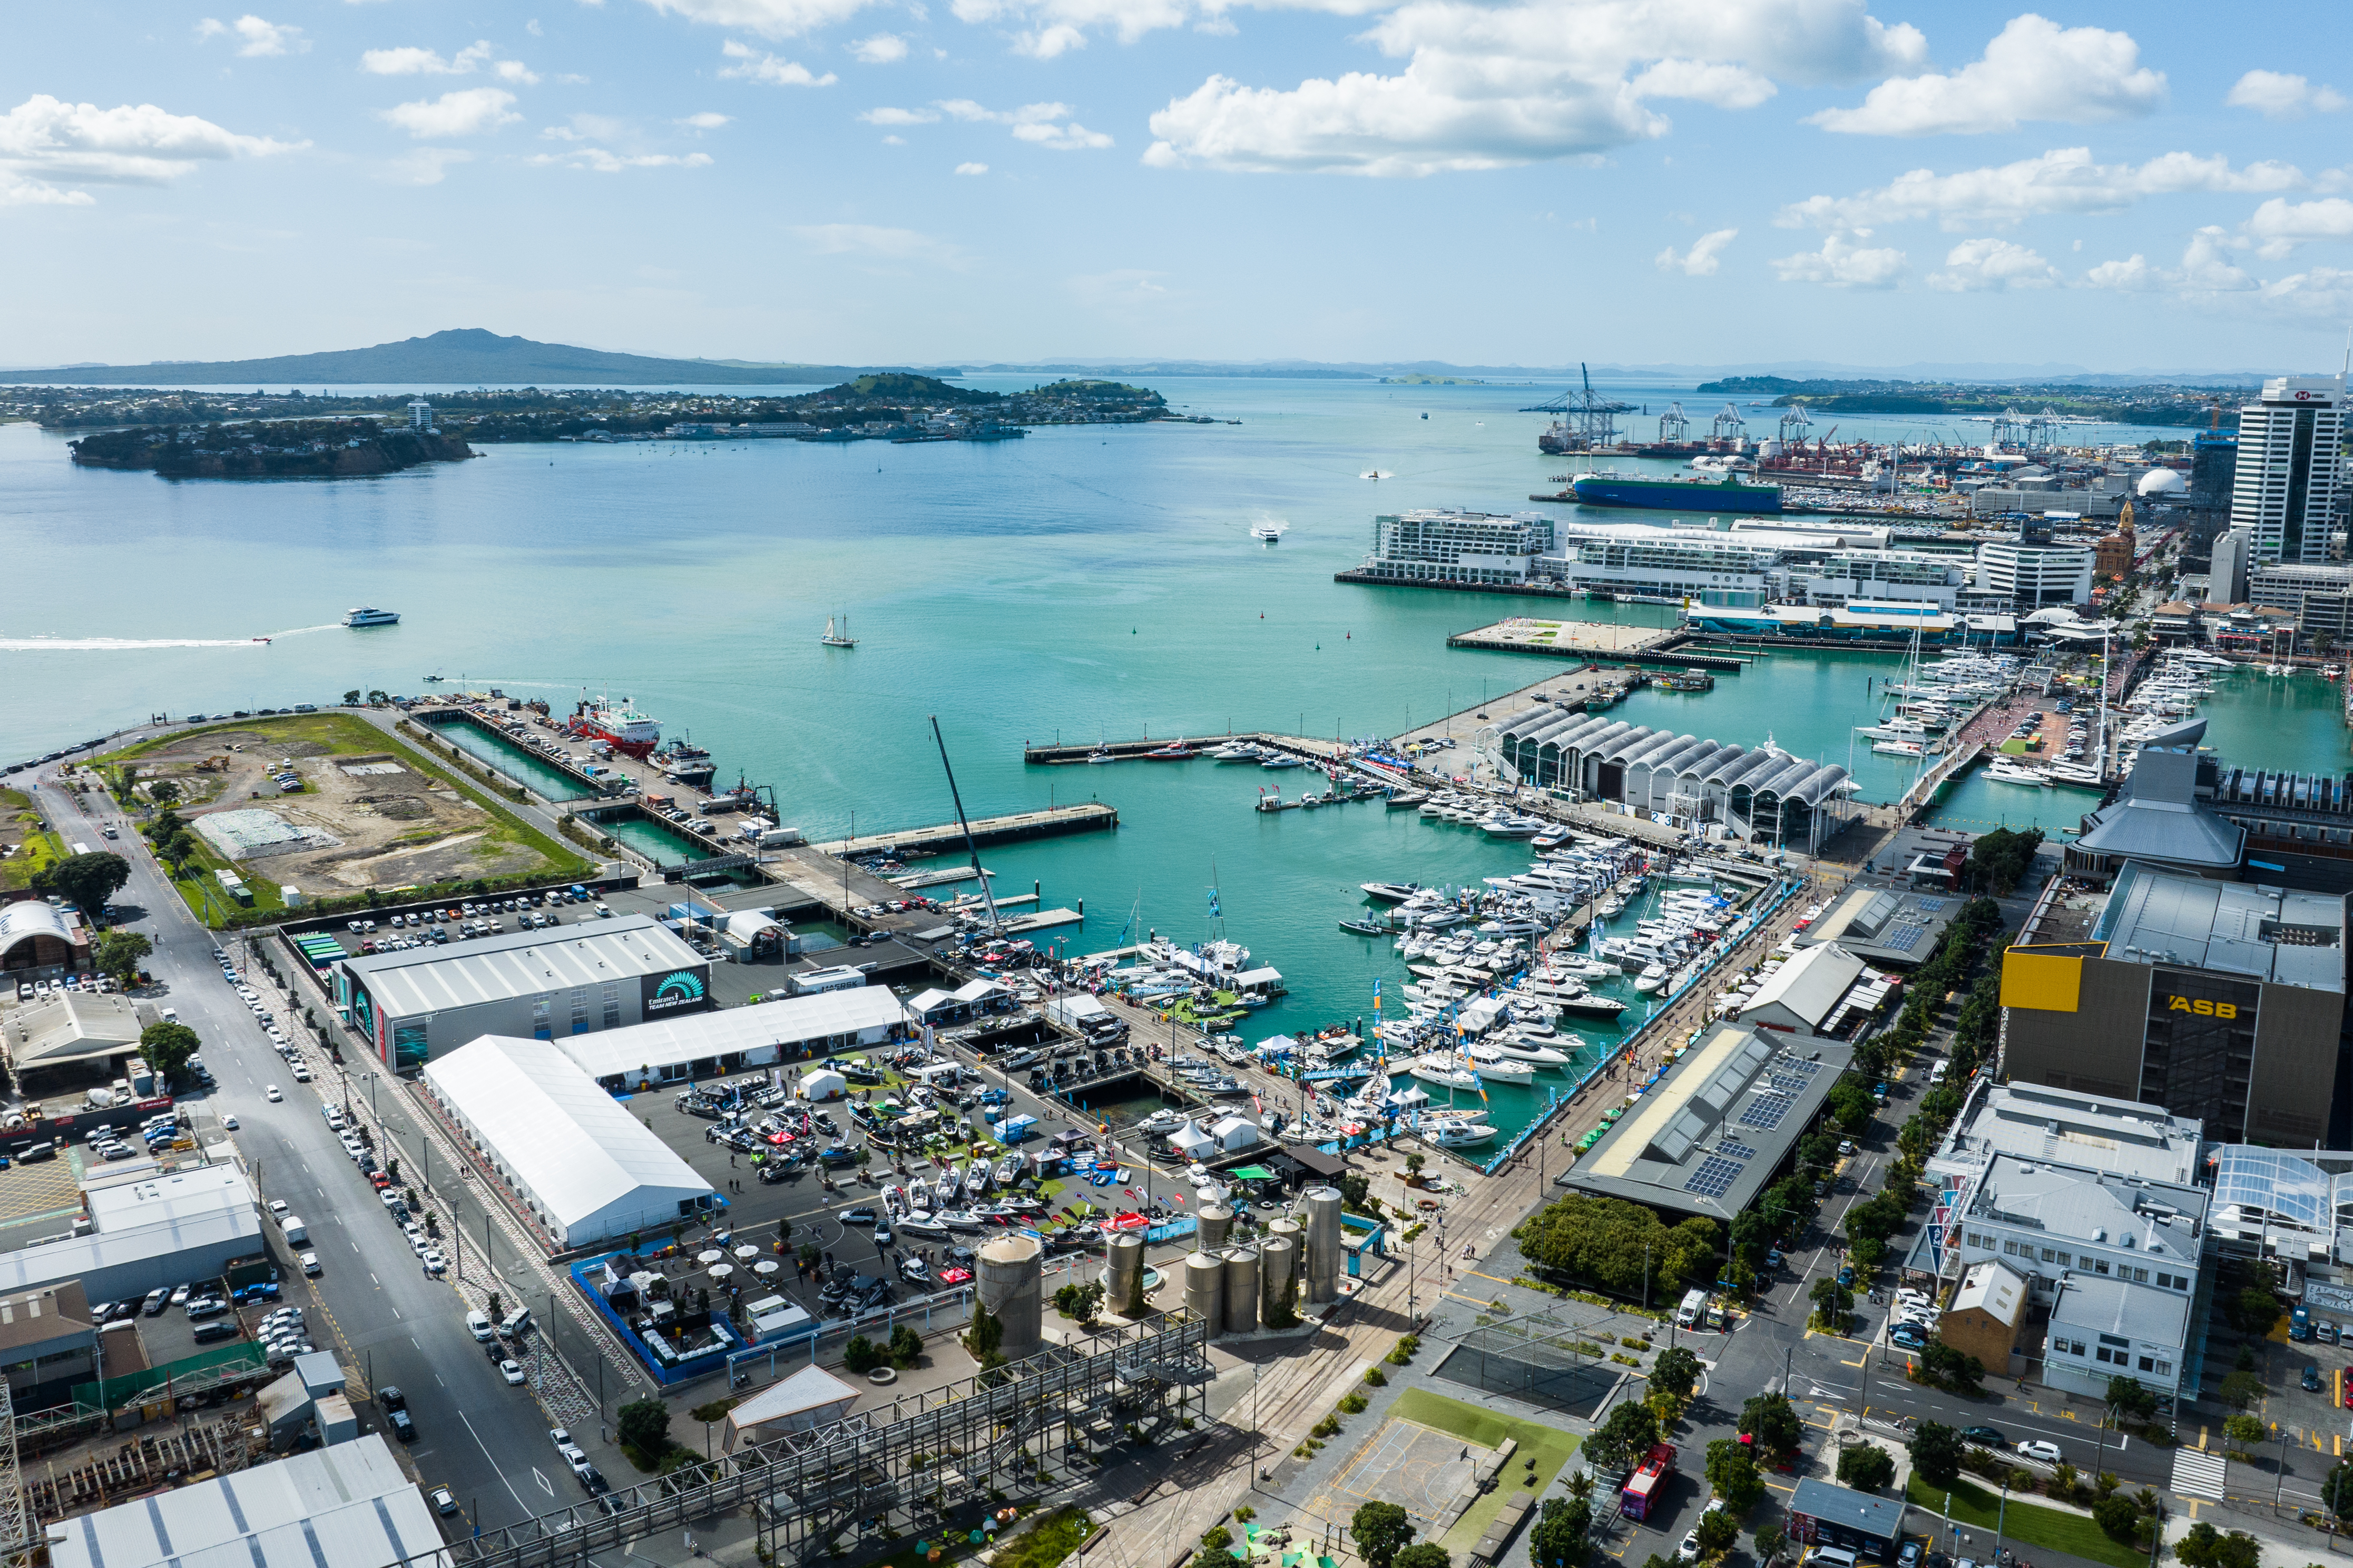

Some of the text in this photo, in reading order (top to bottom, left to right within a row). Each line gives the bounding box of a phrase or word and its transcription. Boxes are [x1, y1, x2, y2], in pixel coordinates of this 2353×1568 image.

[1652, 812, 1658, 823] 2
[1664, 815, 1671, 826] 3
[649, 996, 675, 1005] Emirates
[678, 997, 703, 1005] ZEALAND
[2169, 995, 2237, 1019] ASB
[1933, 1227, 1941, 1246] AFM
